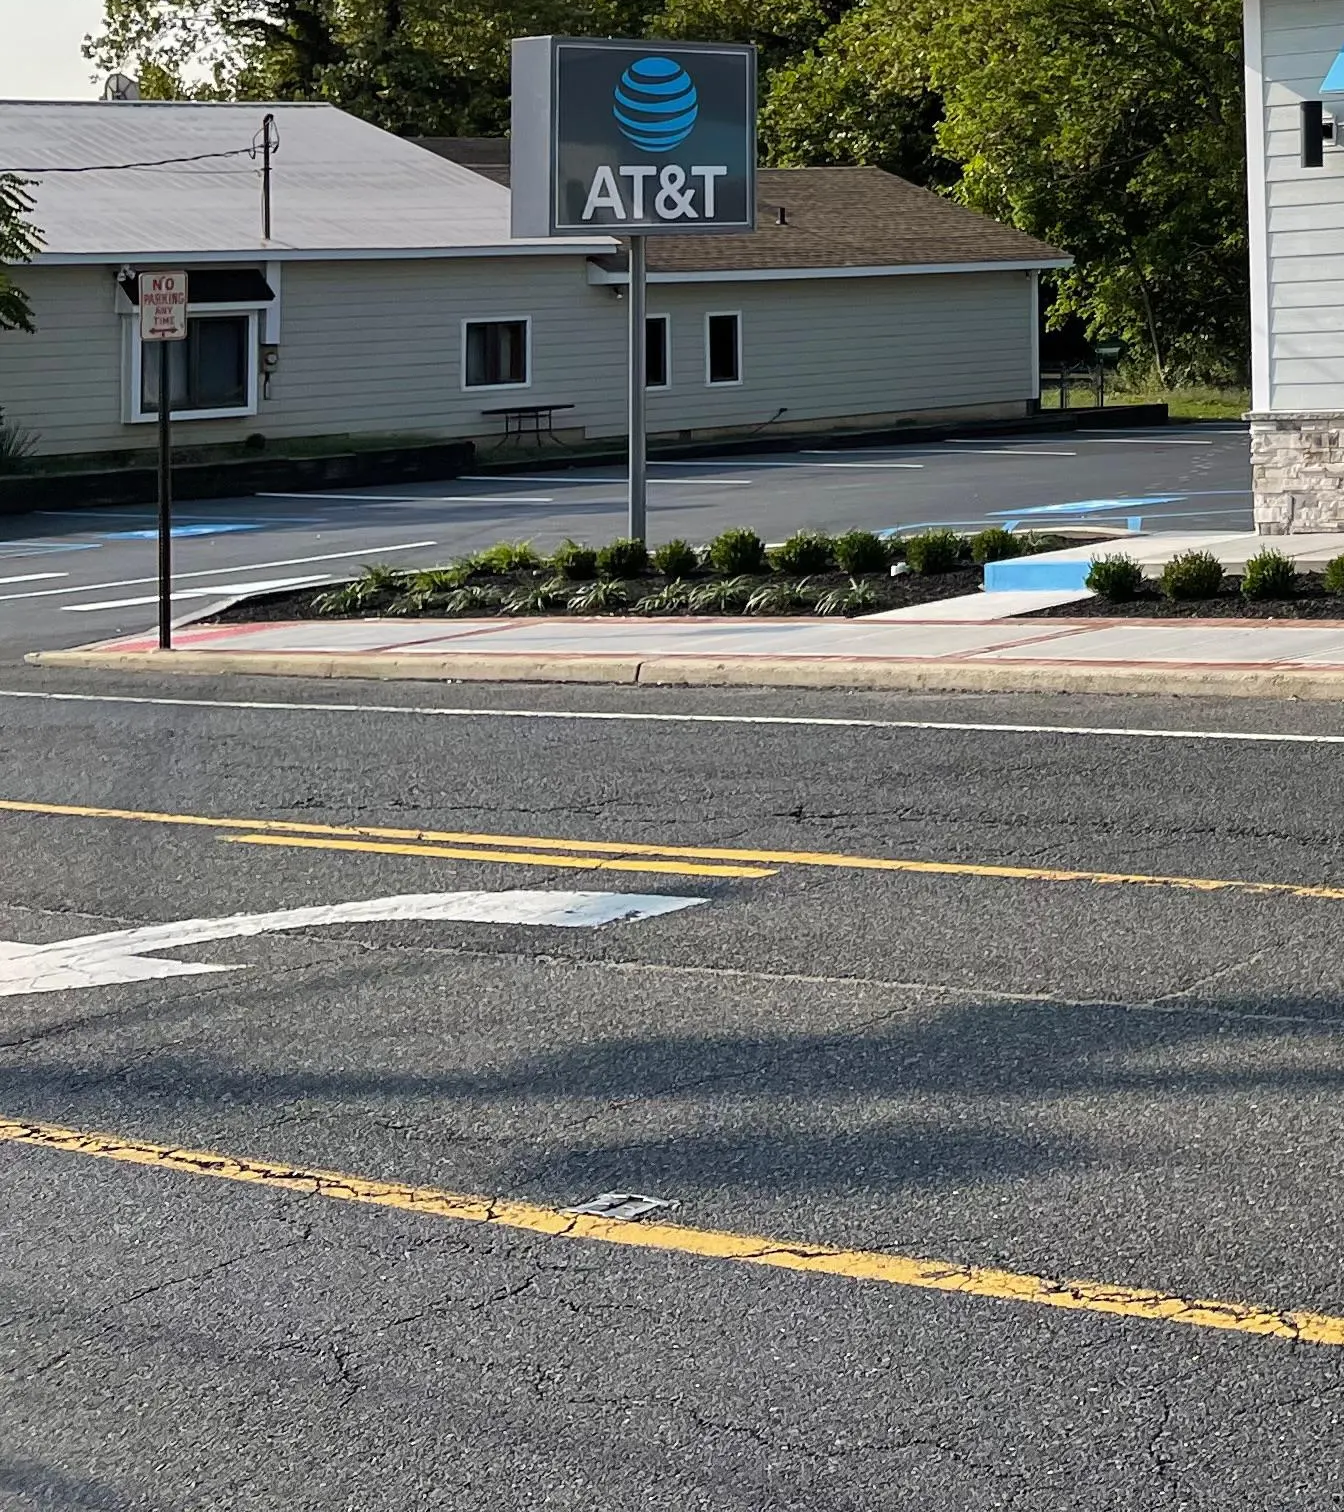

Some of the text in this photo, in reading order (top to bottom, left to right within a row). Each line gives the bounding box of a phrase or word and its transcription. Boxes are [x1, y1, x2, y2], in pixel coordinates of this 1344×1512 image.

[581, 164, 728, 220] AT&T
[152, 277, 175, 291] NO
[143, 292, 185, 306] PARKING
[155, 306, 173, 316] ANY
[154, 316, 176, 326] TIME
